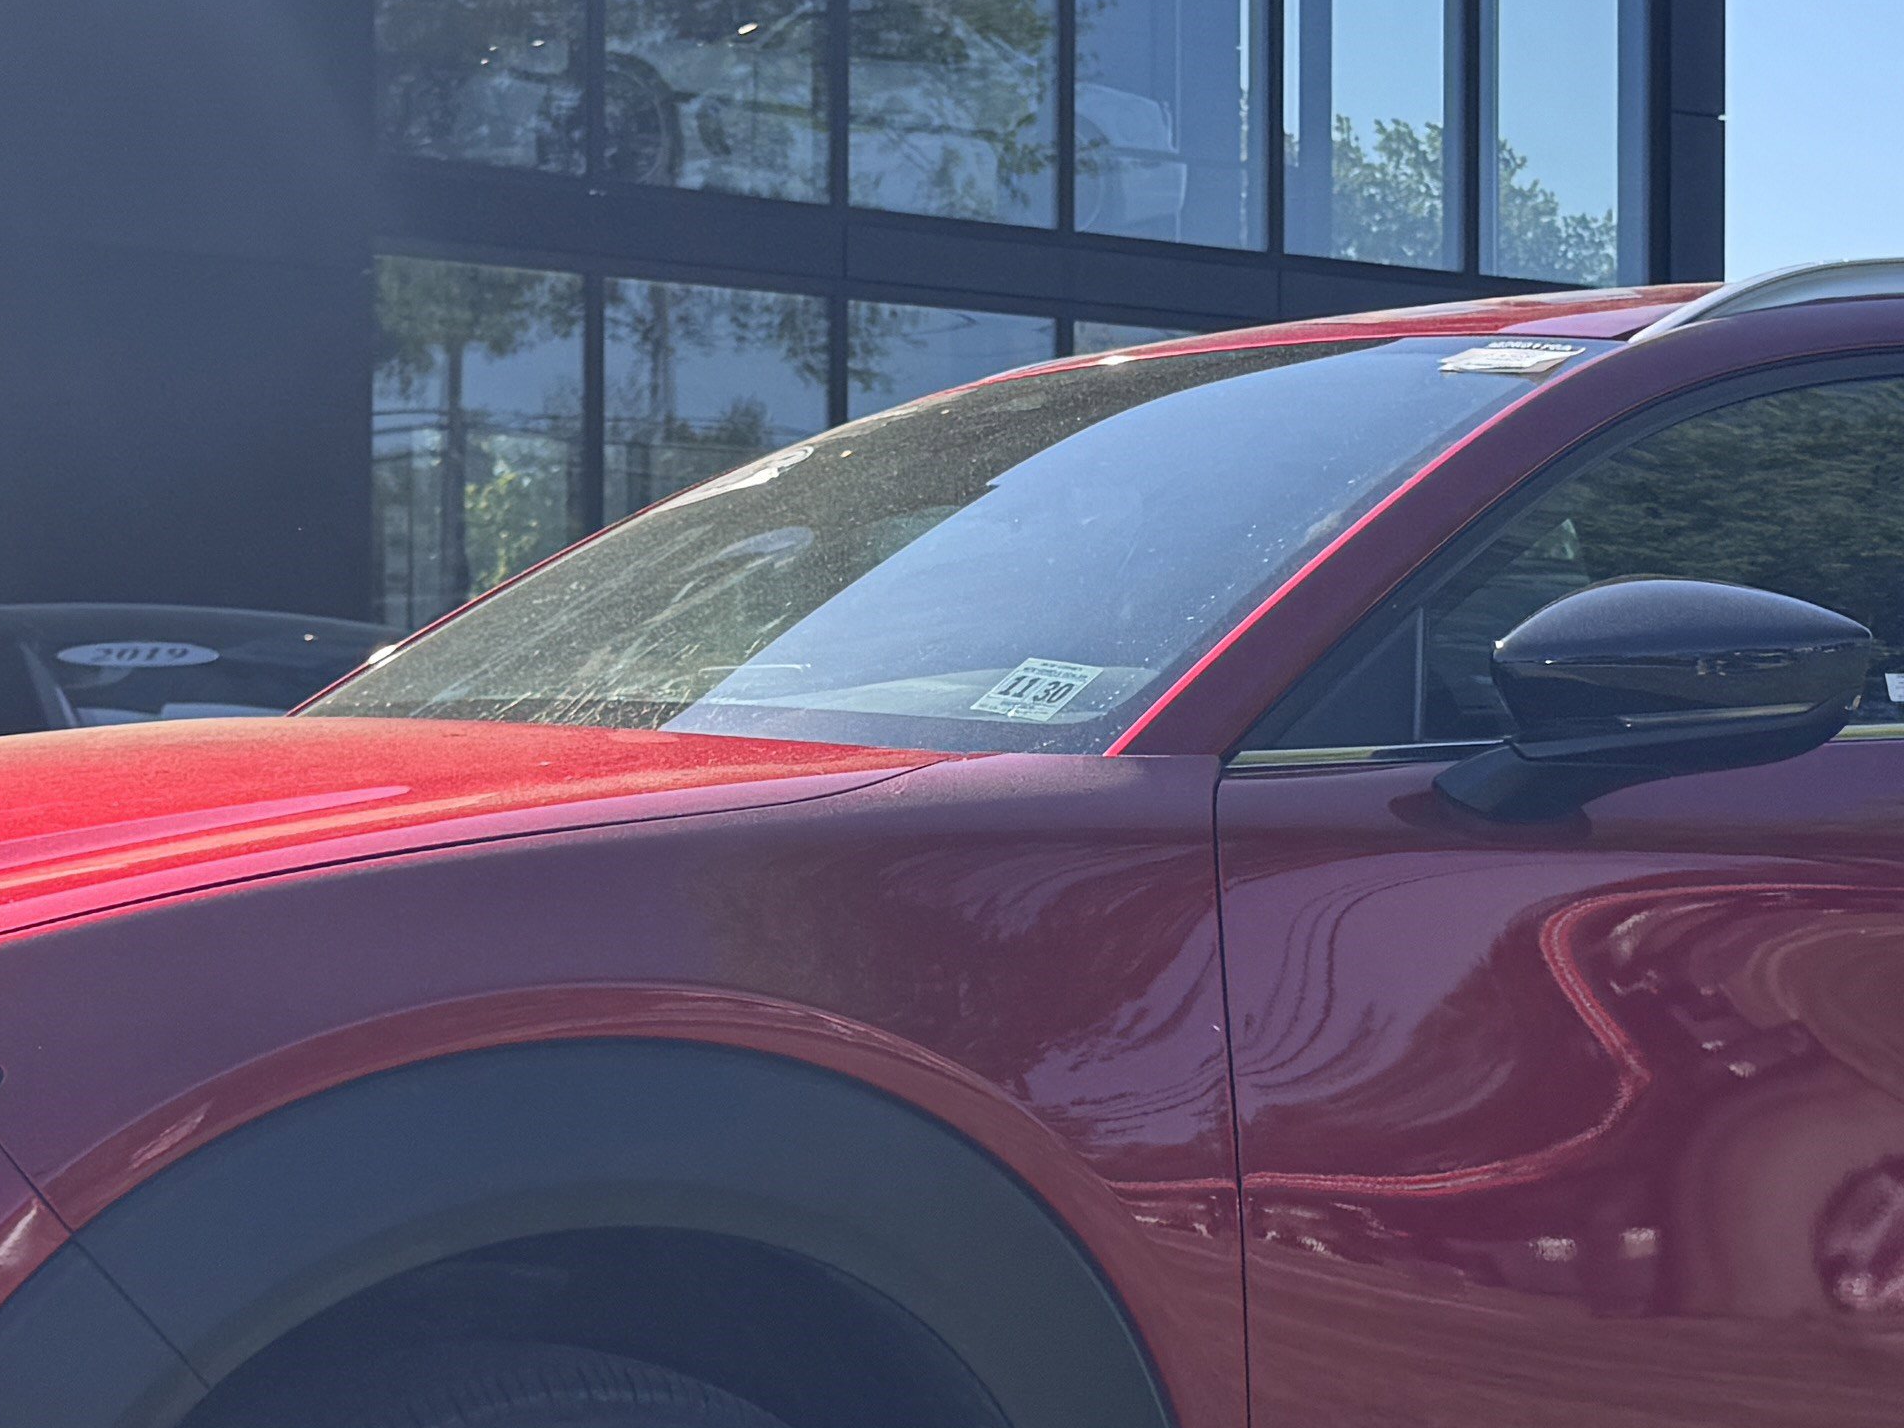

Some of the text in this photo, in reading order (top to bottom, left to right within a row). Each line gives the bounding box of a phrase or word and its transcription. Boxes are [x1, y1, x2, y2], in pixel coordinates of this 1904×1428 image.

[91, 646, 191, 663] 2019
[997, 675, 1075, 704] 11 30
